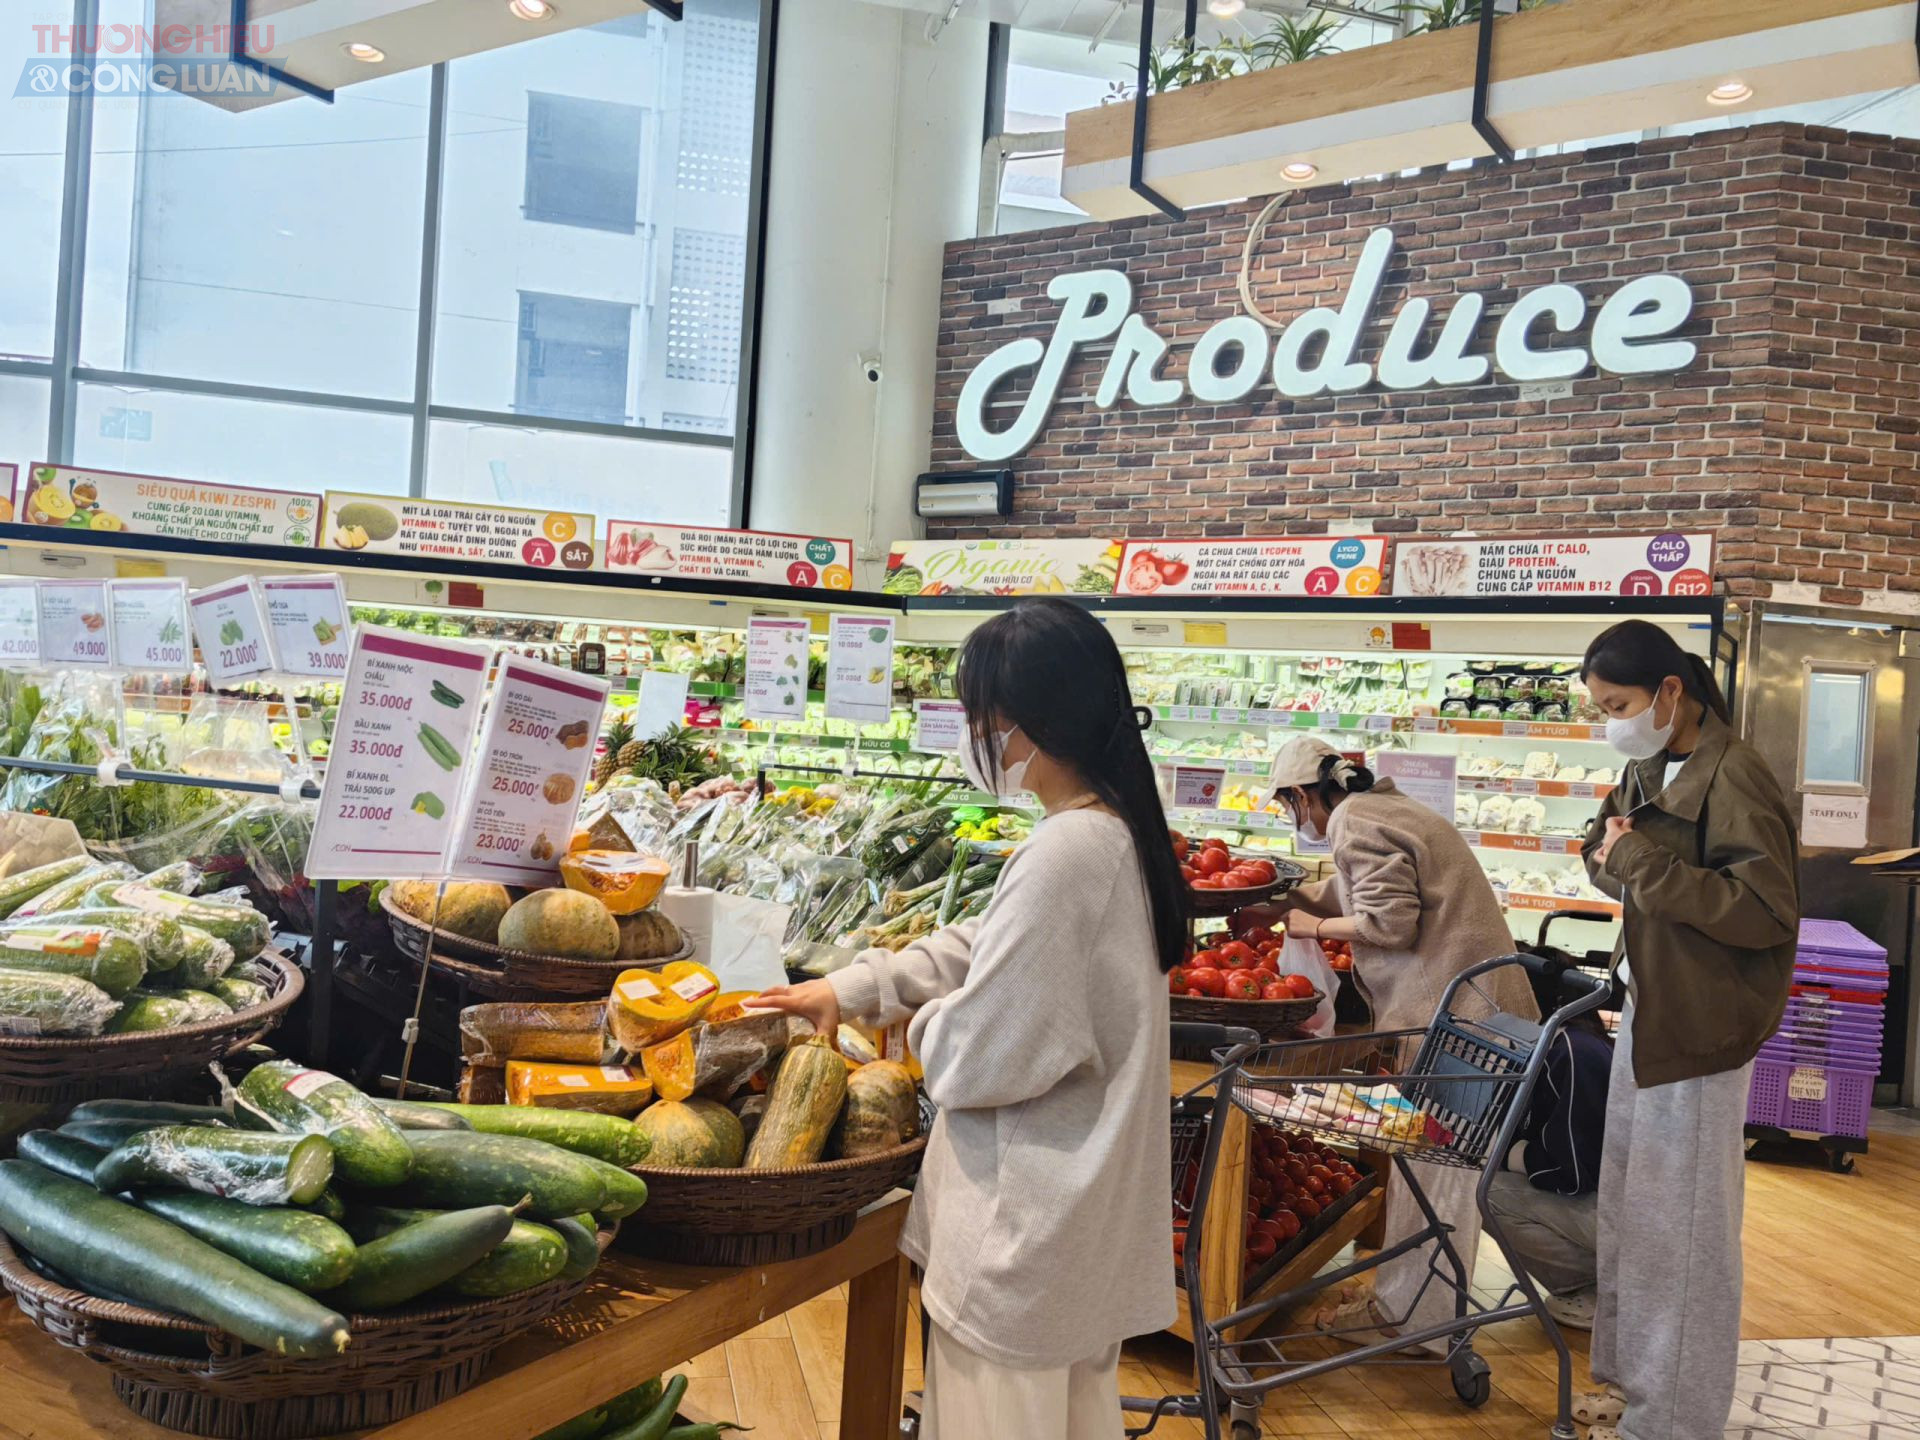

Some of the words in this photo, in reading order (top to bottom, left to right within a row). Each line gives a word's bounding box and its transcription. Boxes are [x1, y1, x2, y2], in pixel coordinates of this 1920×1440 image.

[956, 228, 1698, 462] Produce
[137, 483, 166, 498] SIÊU
[199, 490, 228, 504] KIWI
[232, 494, 276, 510] ZESPRI
[292, 498, 312, 507] 100%
[132, 511, 168, 522] KHOÁNG
[171, 514, 192, 525] CHẤT
[147, 502, 171, 512] CUNG
[174, 502, 190, 514] CẤP
[192, 506, 202, 515] 20
[225, 510, 261, 522] VITAMIN,
[402, 506, 417, 515] MÍT
[494, 513, 505, 522] CÓ
[201, 529, 219, 540] CHO
[402, 518, 436, 528] VITAMIN
[440, 521, 445, 529] C
[522, 529, 532, 537] RA
[552, 522, 565, 538] C
[466, 535, 486, 545] DINH
[756, 538, 765, 546] CÓ
[782, 542, 798, 550] CHO
[1652, 541, 1685, 550] CALO
[420, 544, 454, 554] VITAMIN
[458, 546, 465, 556] A,
[488, 549, 516, 560] CANXI.
[566, 548, 588, 561] SẮT
[809, 543, 832, 552] CHẤT
[1212, 548, 1233, 556] CHUA
[1260, 546, 1302, 555] LYCOPENE
[1480, 542, 1505, 556] NẤM
[1509, 543, 1539, 555] CHỨA
[1543, 542, 1554, 554] ÍT
[1557, 544, 1590, 556] CALO,
[532, 548, 545, 564] A
[680, 554, 711, 563] VITAMIN
[714, 556, 720, 564] A,
[724, 557, 754, 567] VITAMIN
[757, 560, 765, 568] C,
[814, 552, 827, 560] XƠ
[1270, 559, 1286, 567] OXY
[1508, 558, 1559, 567] PROTEIN.
[1651, 551, 1685, 562] THẤP
[726, 569, 750, 578] CANXI.
[924, 548, 1060, 587] Organic
[1478, 566, 1516, 580] CHÚNG
[1537, 566, 1576, 579] NGUỒN
[796, 570, 808, 585] A
[830, 574, 843, 588] C
[984, 576, 1001, 584] RAU
[1002, 574, 1020, 584] HỮU
[1021, 575, 1033, 584] CƠ
[1220, 571, 1230, 579] RA
[1250, 583, 1258, 592] A,
[1274, 583, 1282, 591] K.
[1313, 576, 1327, 592] A
[1355, 576, 1370, 592] C
[1477, 582, 1506, 592] CUNG
[1511, 578, 1533, 591] CẤP
[1538, 582, 1585, 591] VITAMIN
[1590, 581, 1611, 591] B12
[1633, 582, 1650, 596] D
[1675, 583, 1707, 596] B12
[2, 640, 36, 653] 42.000
[73, 641, 105, 656] 49.000
[367, 658, 375, 667] BÍ
[375, 660, 396, 670] XANH
[397, 663, 414, 674] MỘC
[364, 670, 384, 681] CHÂU
[360, 691, 413, 711] 35.000đ
[1545, 727, 1568, 736] TƯƠI
[350, 740, 403, 758] 35.000đ
[346, 769, 356, 779] BÍ
[357, 772, 378, 780] XANH
[344, 784, 362, 792] TRÁI
[363, 786, 383, 795] 500G
[339, 805, 393, 820] 22.000đ
[1809, 808, 1834, 818] STAFF
[1836, 810, 1860, 820] ONLY
